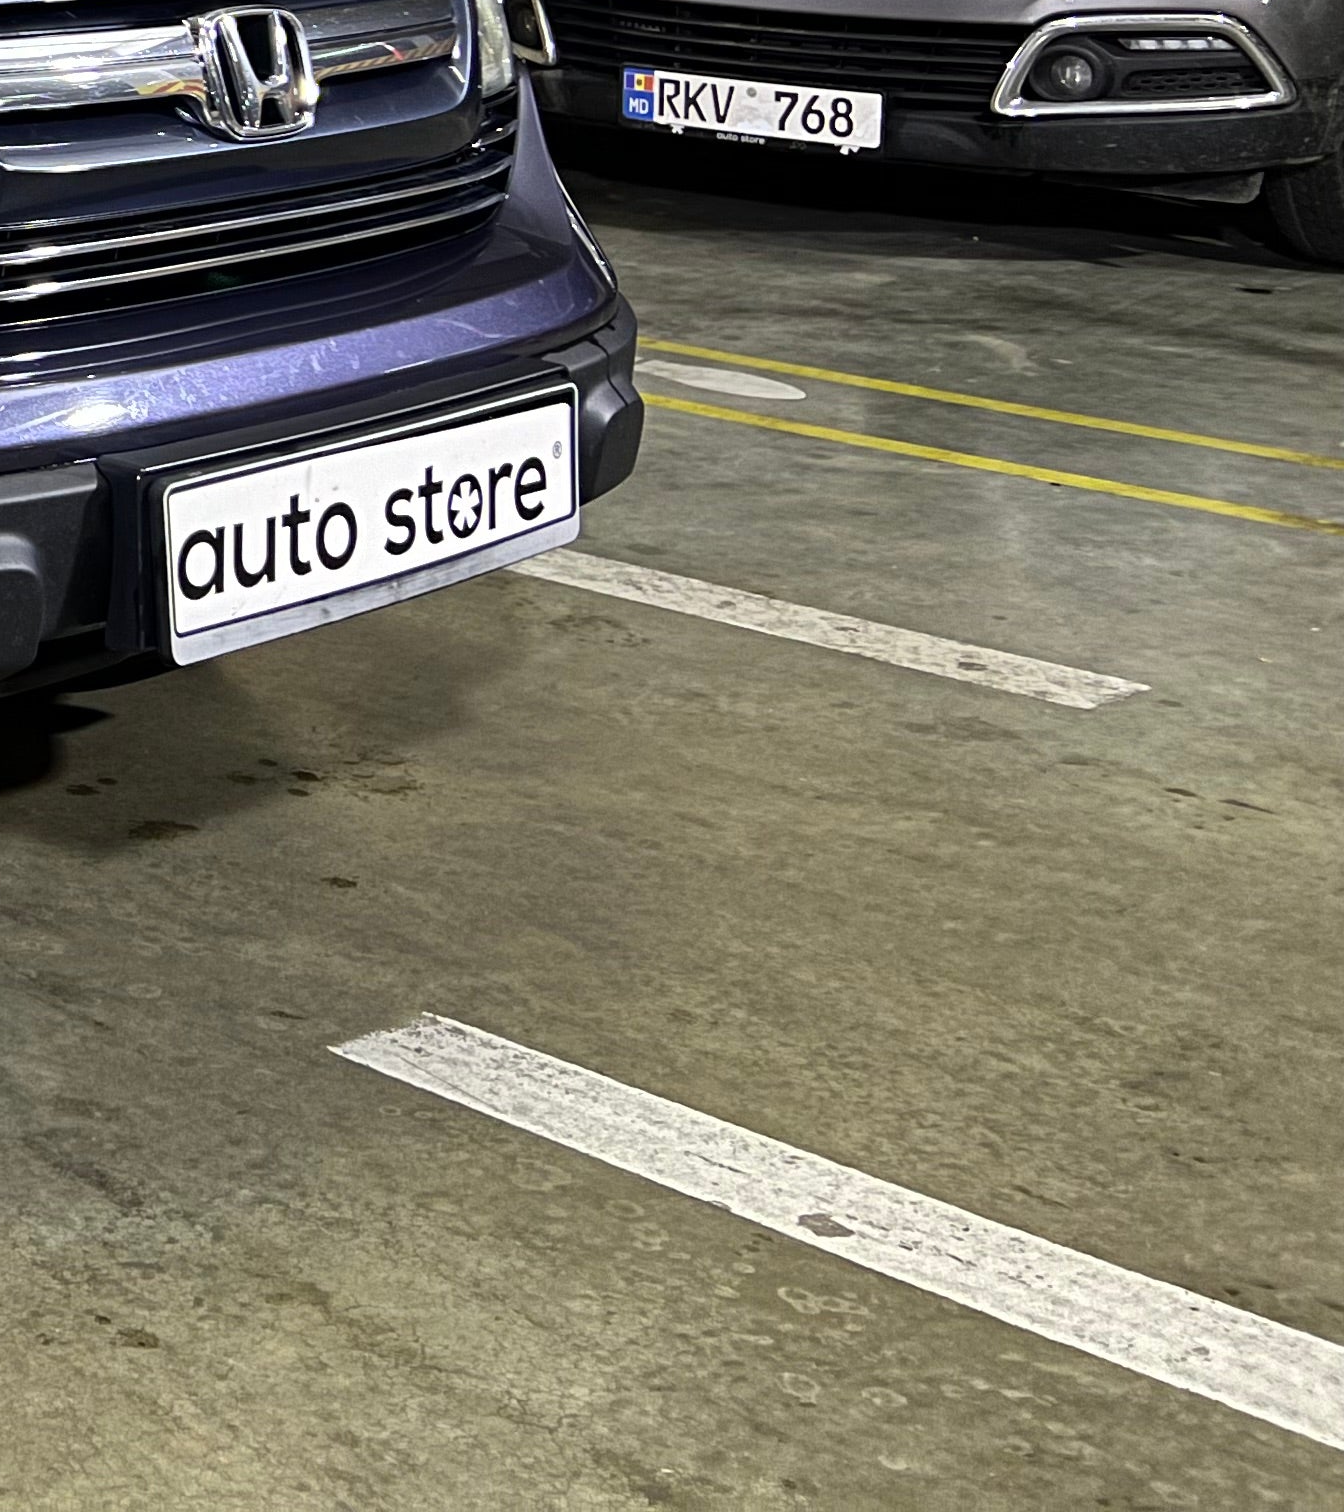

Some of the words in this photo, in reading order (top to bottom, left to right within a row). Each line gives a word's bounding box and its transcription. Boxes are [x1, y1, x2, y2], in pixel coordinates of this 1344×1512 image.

[629, 97, 649, 115] MD
[658, 78, 735, 124] RKV
[774, 91, 854, 138] 768
[716, 132, 739, 142] auto
[740, 134, 766, 145] store
[178, 493, 358, 600] auto
[384, 456, 548, 555] store
